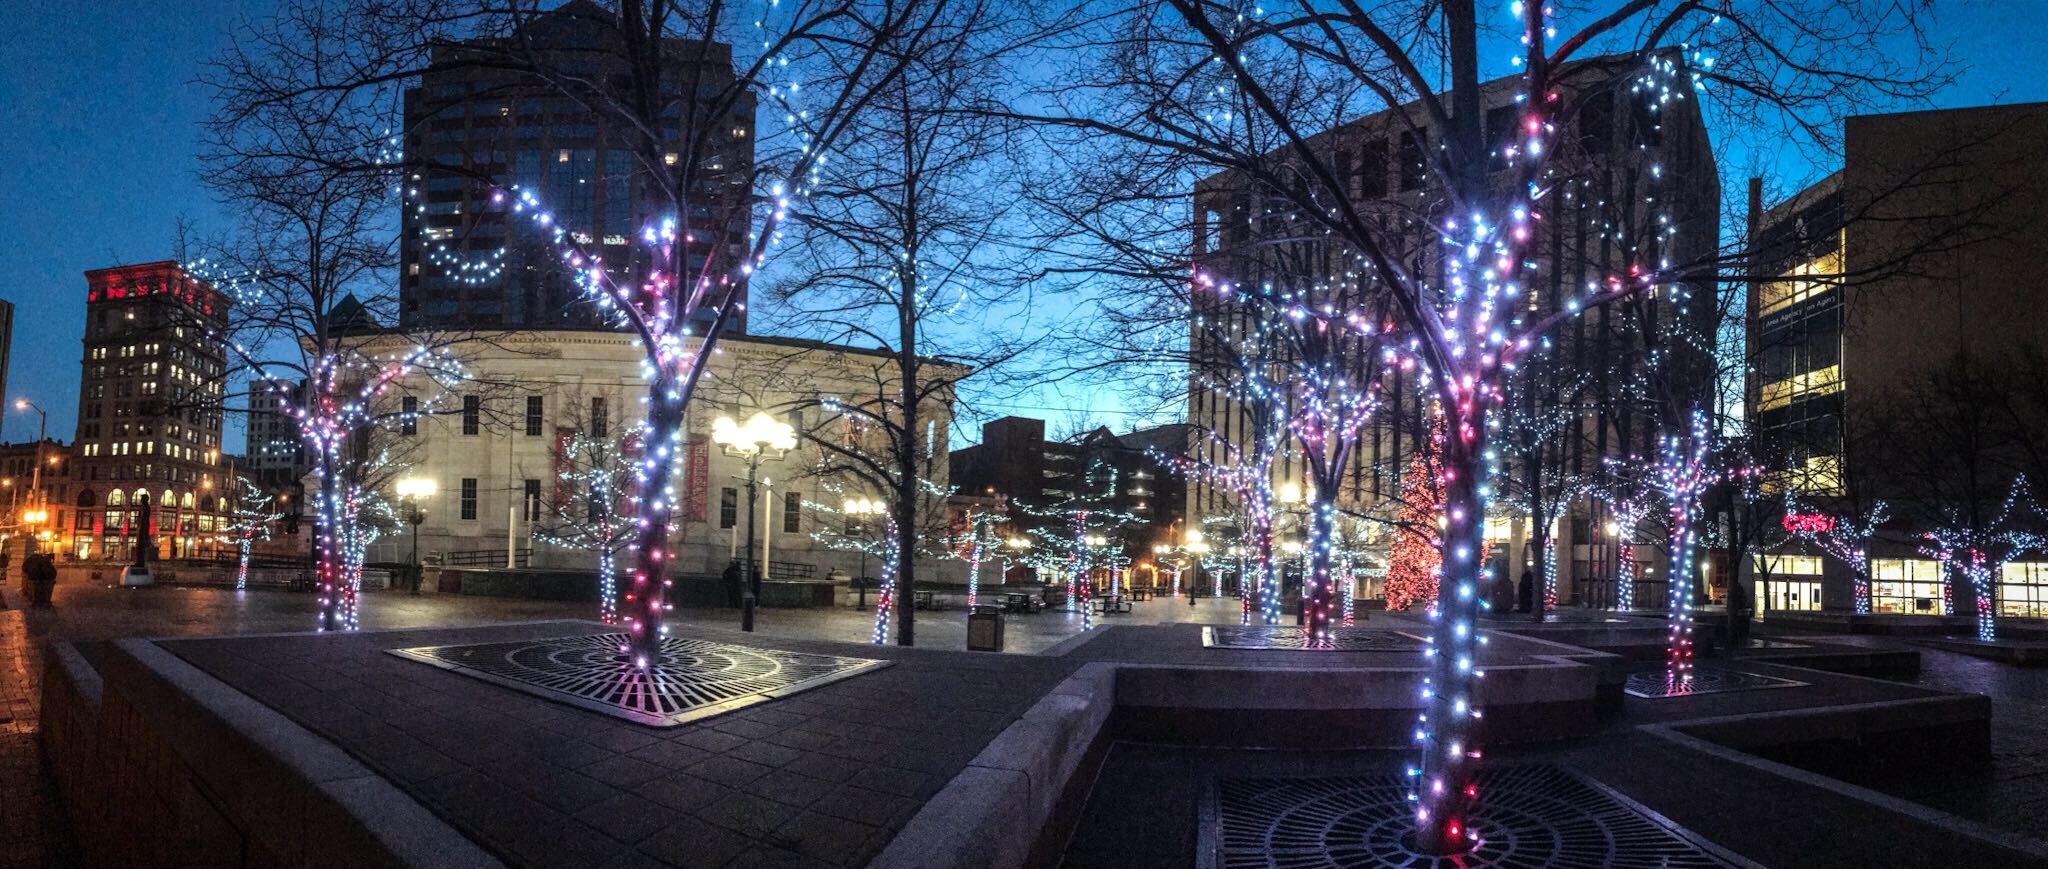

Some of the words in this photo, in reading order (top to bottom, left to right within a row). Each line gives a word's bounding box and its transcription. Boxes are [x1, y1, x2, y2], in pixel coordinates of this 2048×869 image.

[1766, 319, 1779, 327] Area
[1780, 309, 1802, 322] Agency
[1816, 296, 1836, 308] Aging
